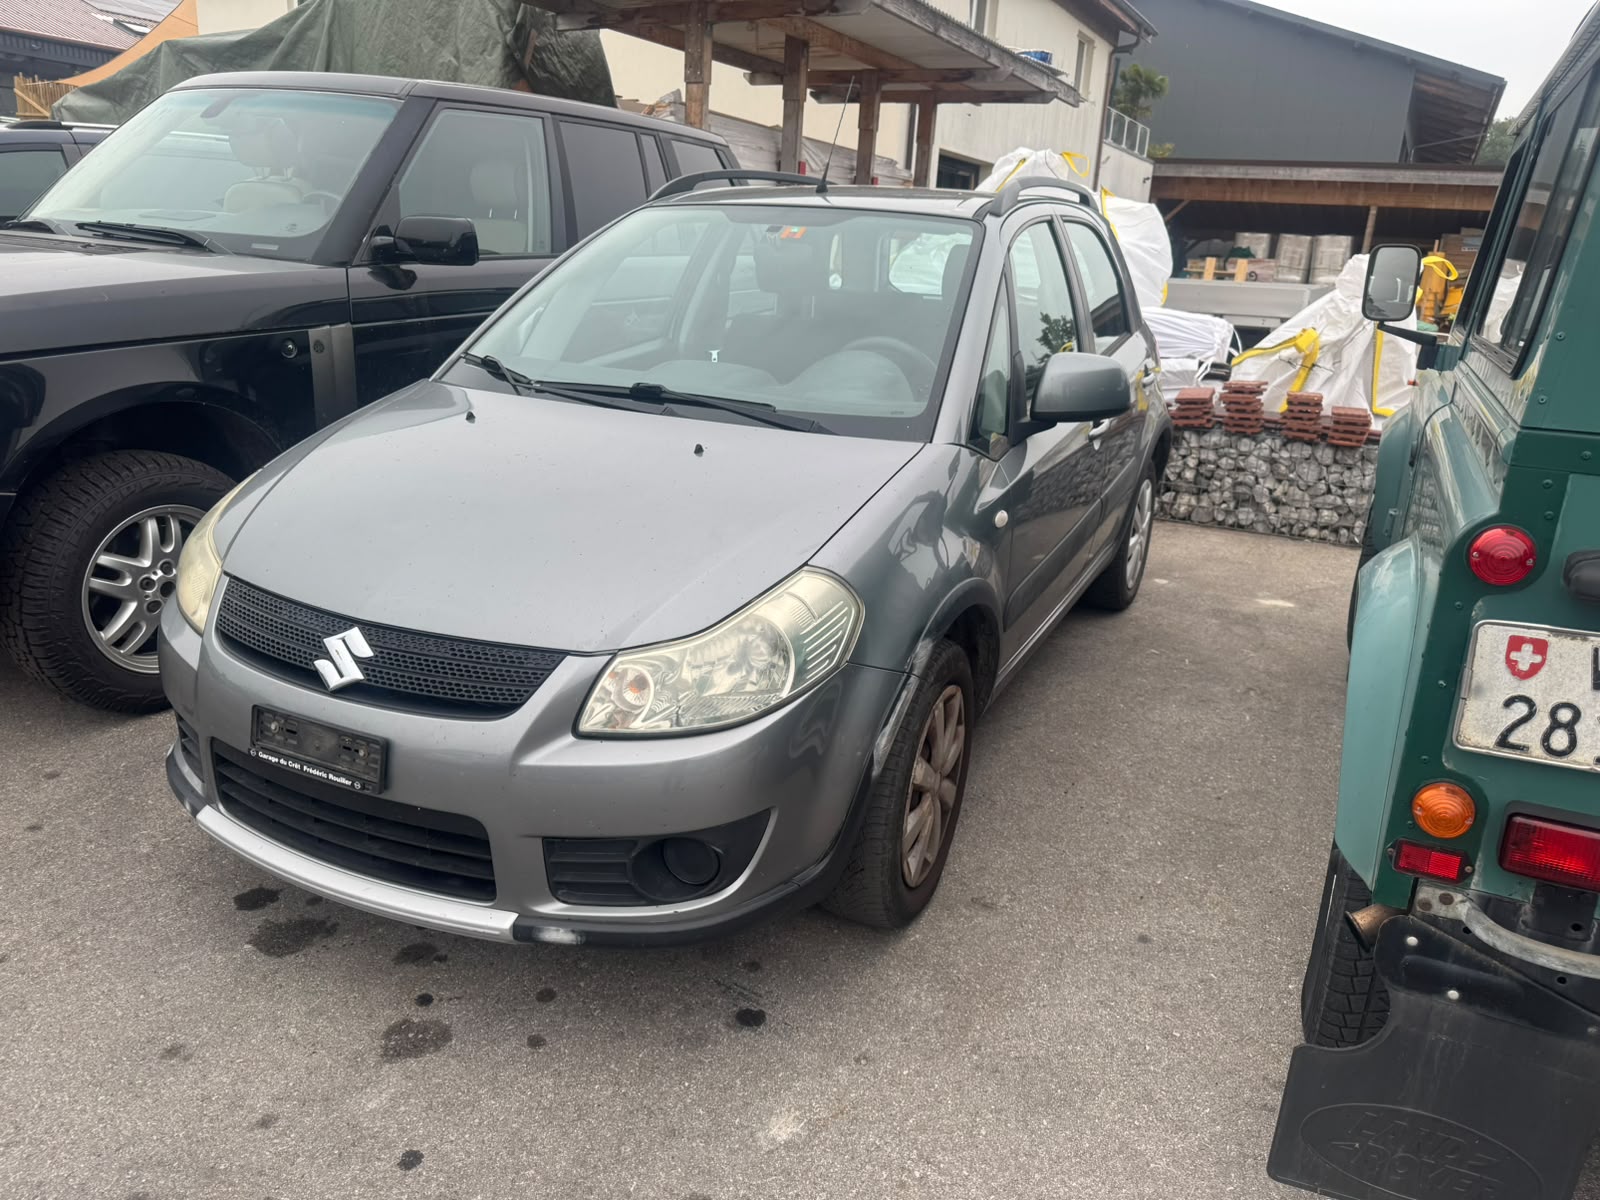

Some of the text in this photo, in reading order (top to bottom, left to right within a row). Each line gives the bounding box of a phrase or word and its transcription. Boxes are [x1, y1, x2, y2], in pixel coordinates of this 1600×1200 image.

[1494, 694, 1600, 764] 28
[258, 751, 279, 763] Garage
[279, 757, 288, 766] du
[288, 760, 301, 771] Crêt
[303, 764, 328, 779] Frédéric
